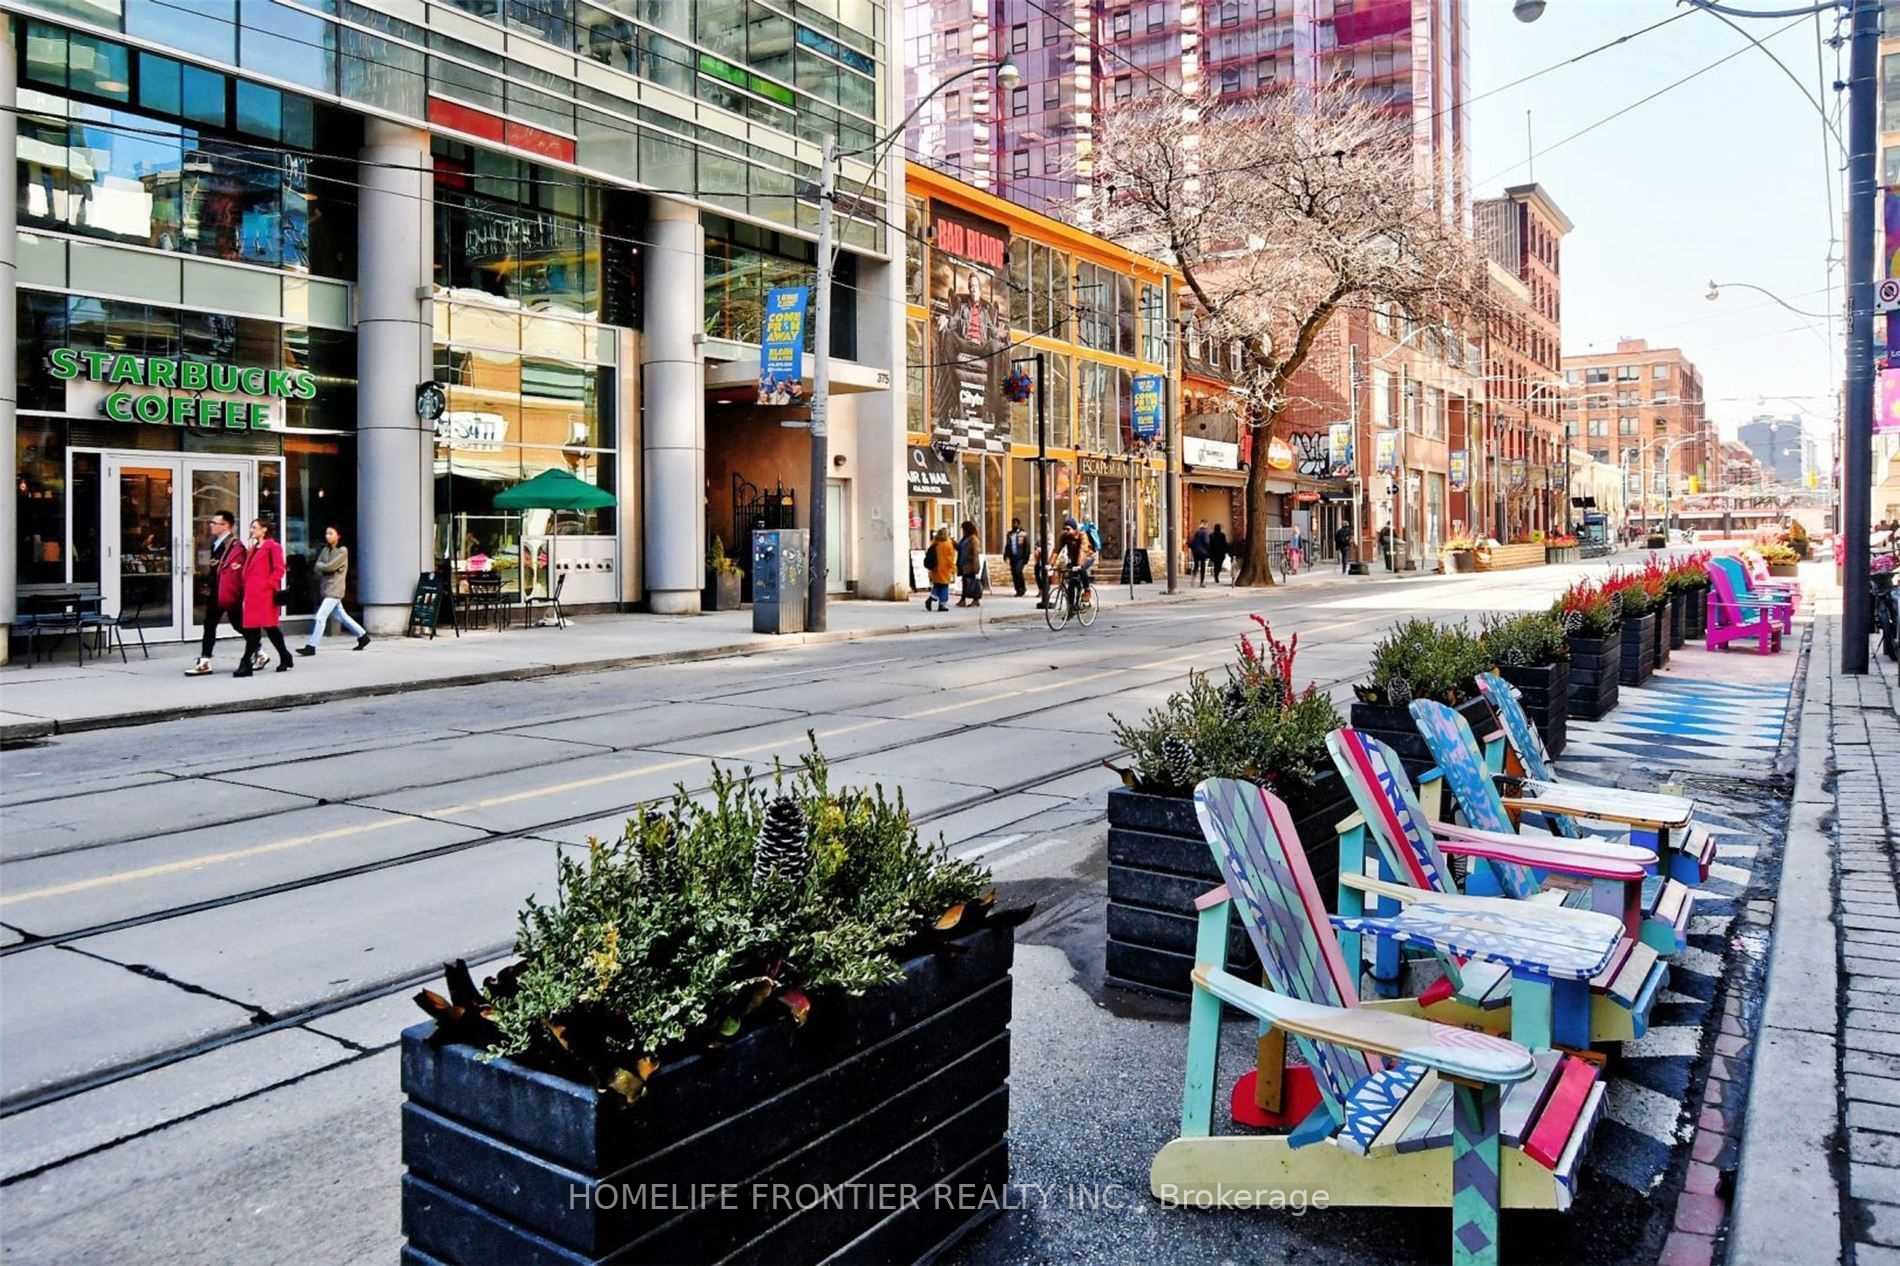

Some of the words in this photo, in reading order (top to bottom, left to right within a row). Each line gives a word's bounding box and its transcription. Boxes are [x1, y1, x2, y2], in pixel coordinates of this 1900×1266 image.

[938, 218, 964, 256] BAD
[50, 347, 318, 400] STARBUCKS
[877, 373, 890, 385] 375
[104, 392, 272, 429] COFFEE
